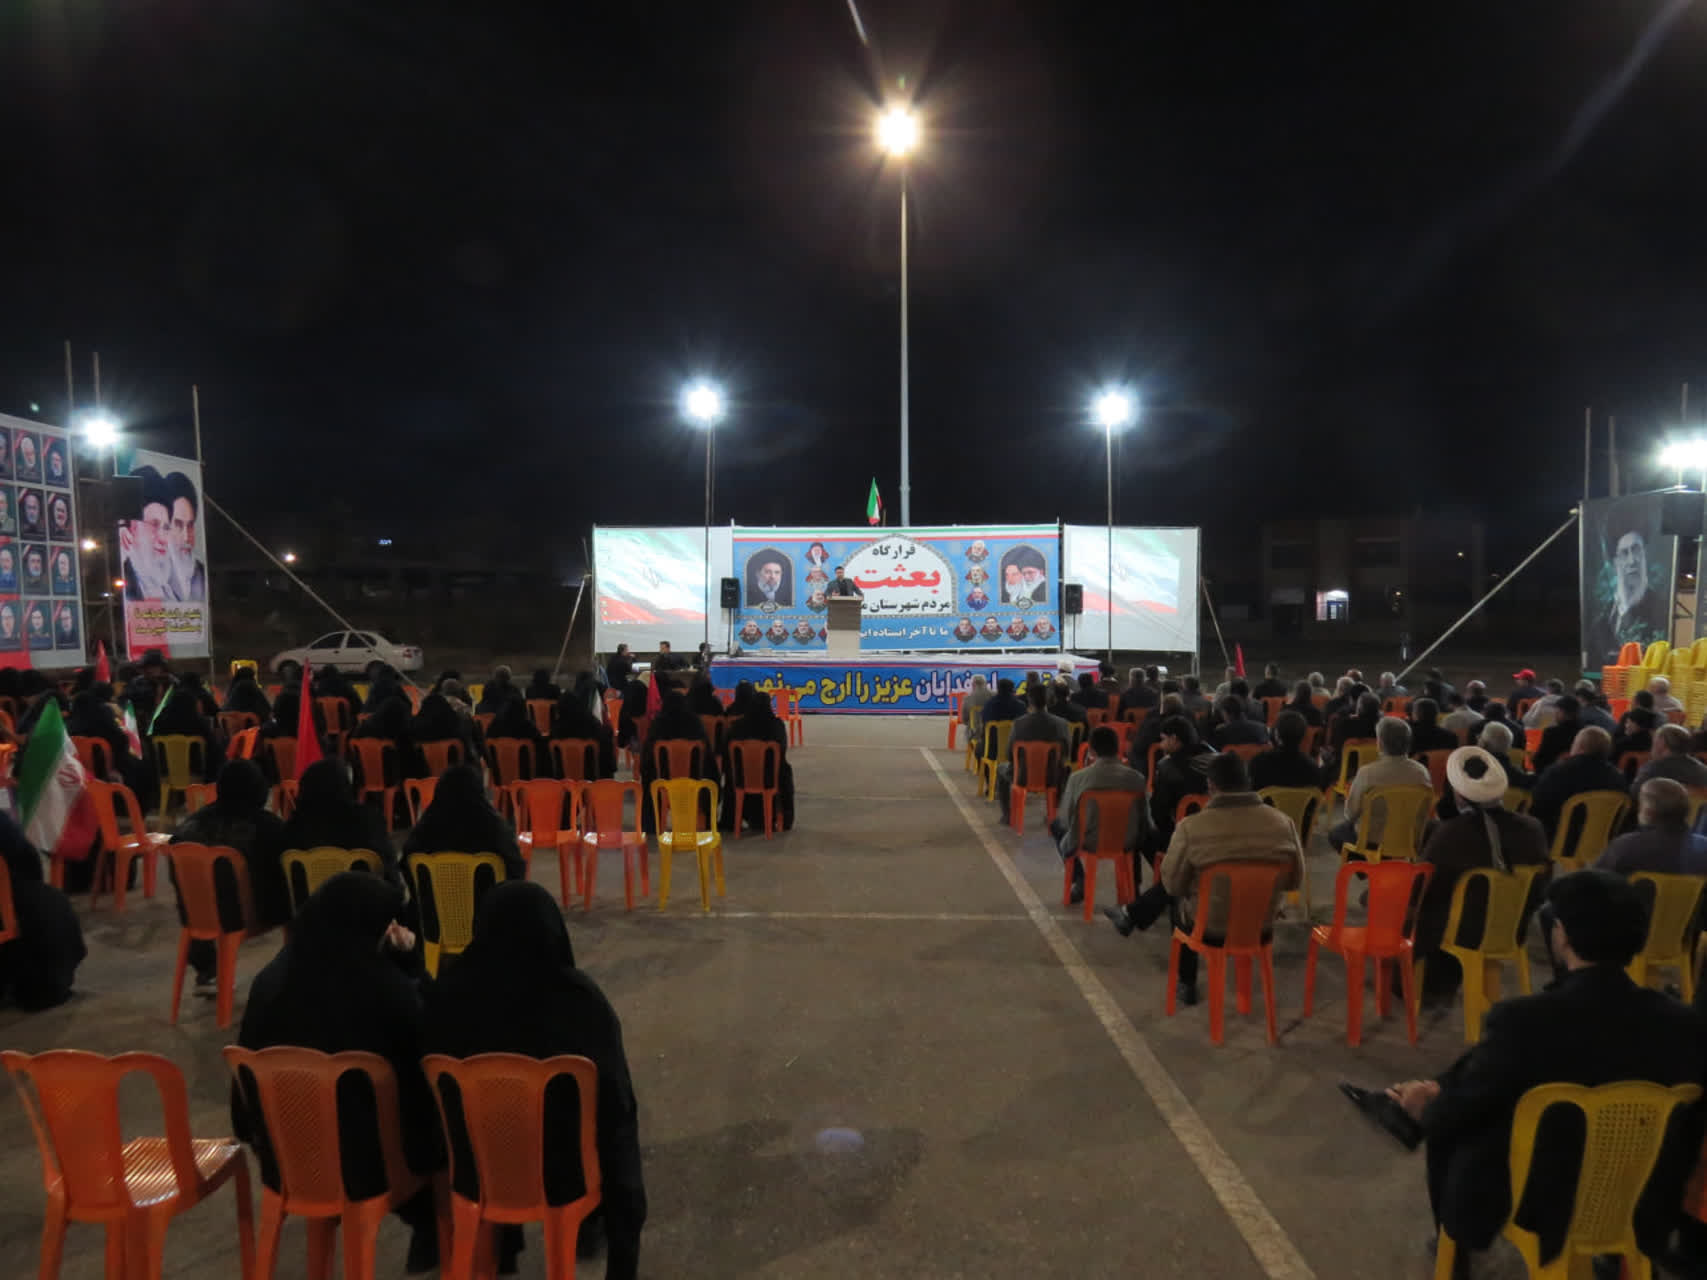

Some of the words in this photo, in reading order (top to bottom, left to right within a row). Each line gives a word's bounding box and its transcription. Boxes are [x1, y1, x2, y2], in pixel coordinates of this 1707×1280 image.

[853, 563, 941, 595] بعثت
[870, 599, 919, 613] شهرستان
[921, 600, 951, 612] مردم
[819, 671, 852, 705] ارج
[855, 671, 869, 704] را
[872, 675, 914, 704] عزیز
